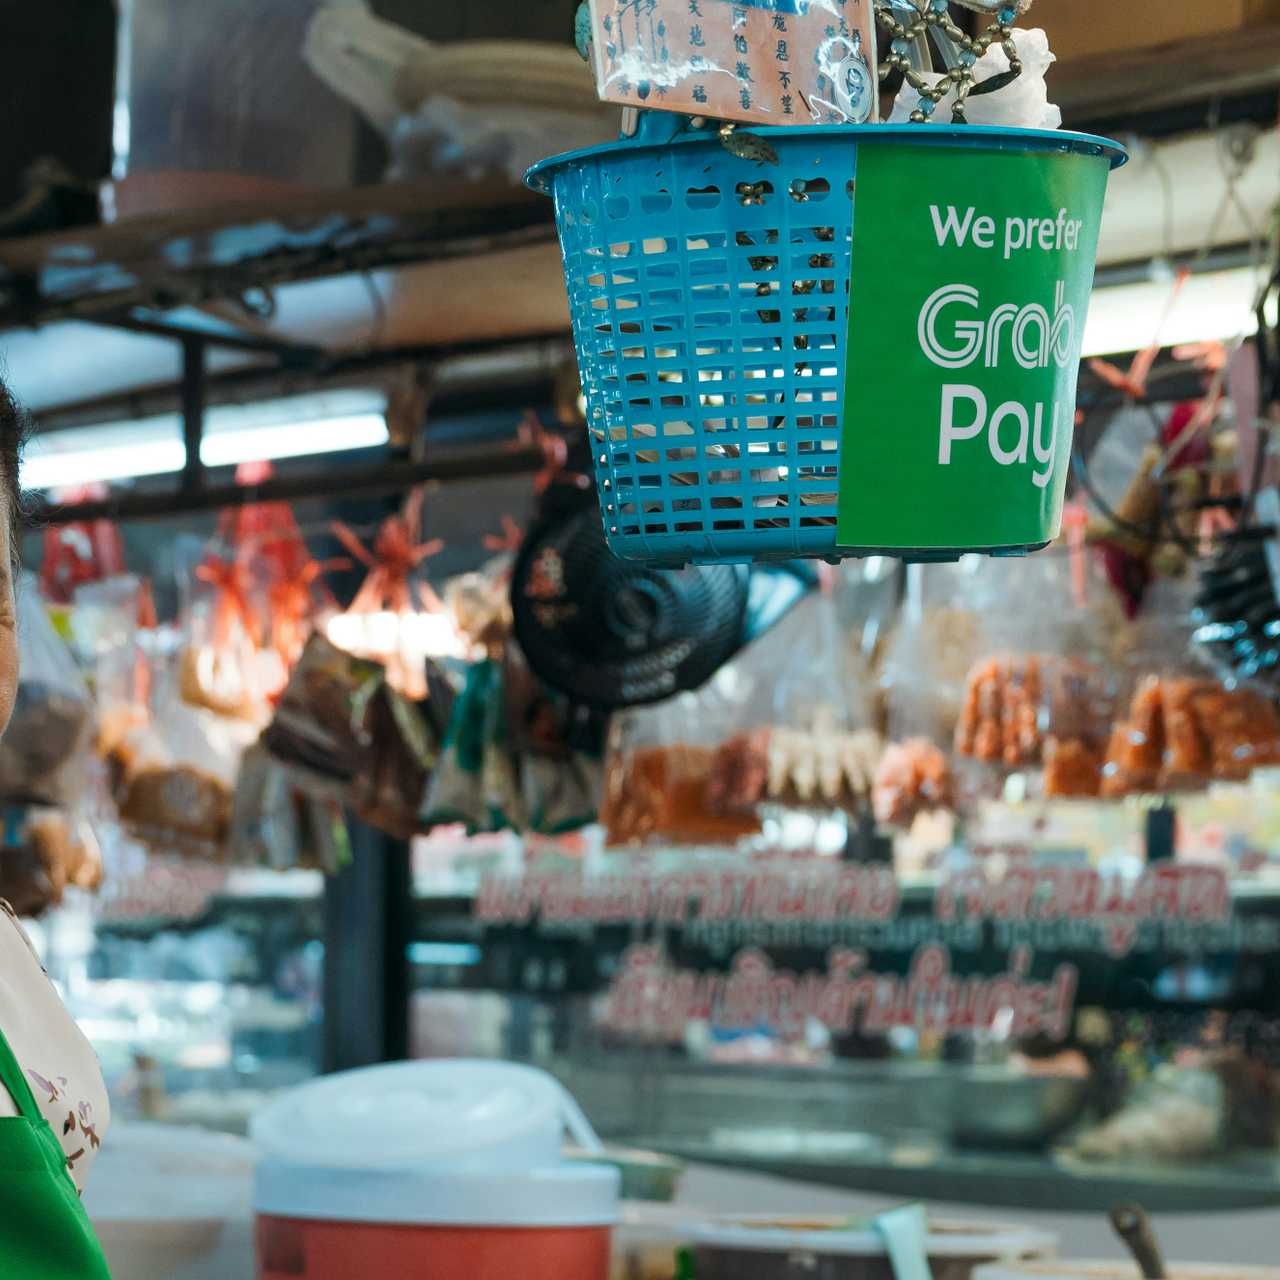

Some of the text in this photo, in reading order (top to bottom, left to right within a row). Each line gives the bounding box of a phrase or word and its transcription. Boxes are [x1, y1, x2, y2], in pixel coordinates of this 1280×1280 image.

[930, 206, 1082, 258] We prefer
[918, 281, 1074, 369] Grab
[938, 384, 1060, 488] Pay
